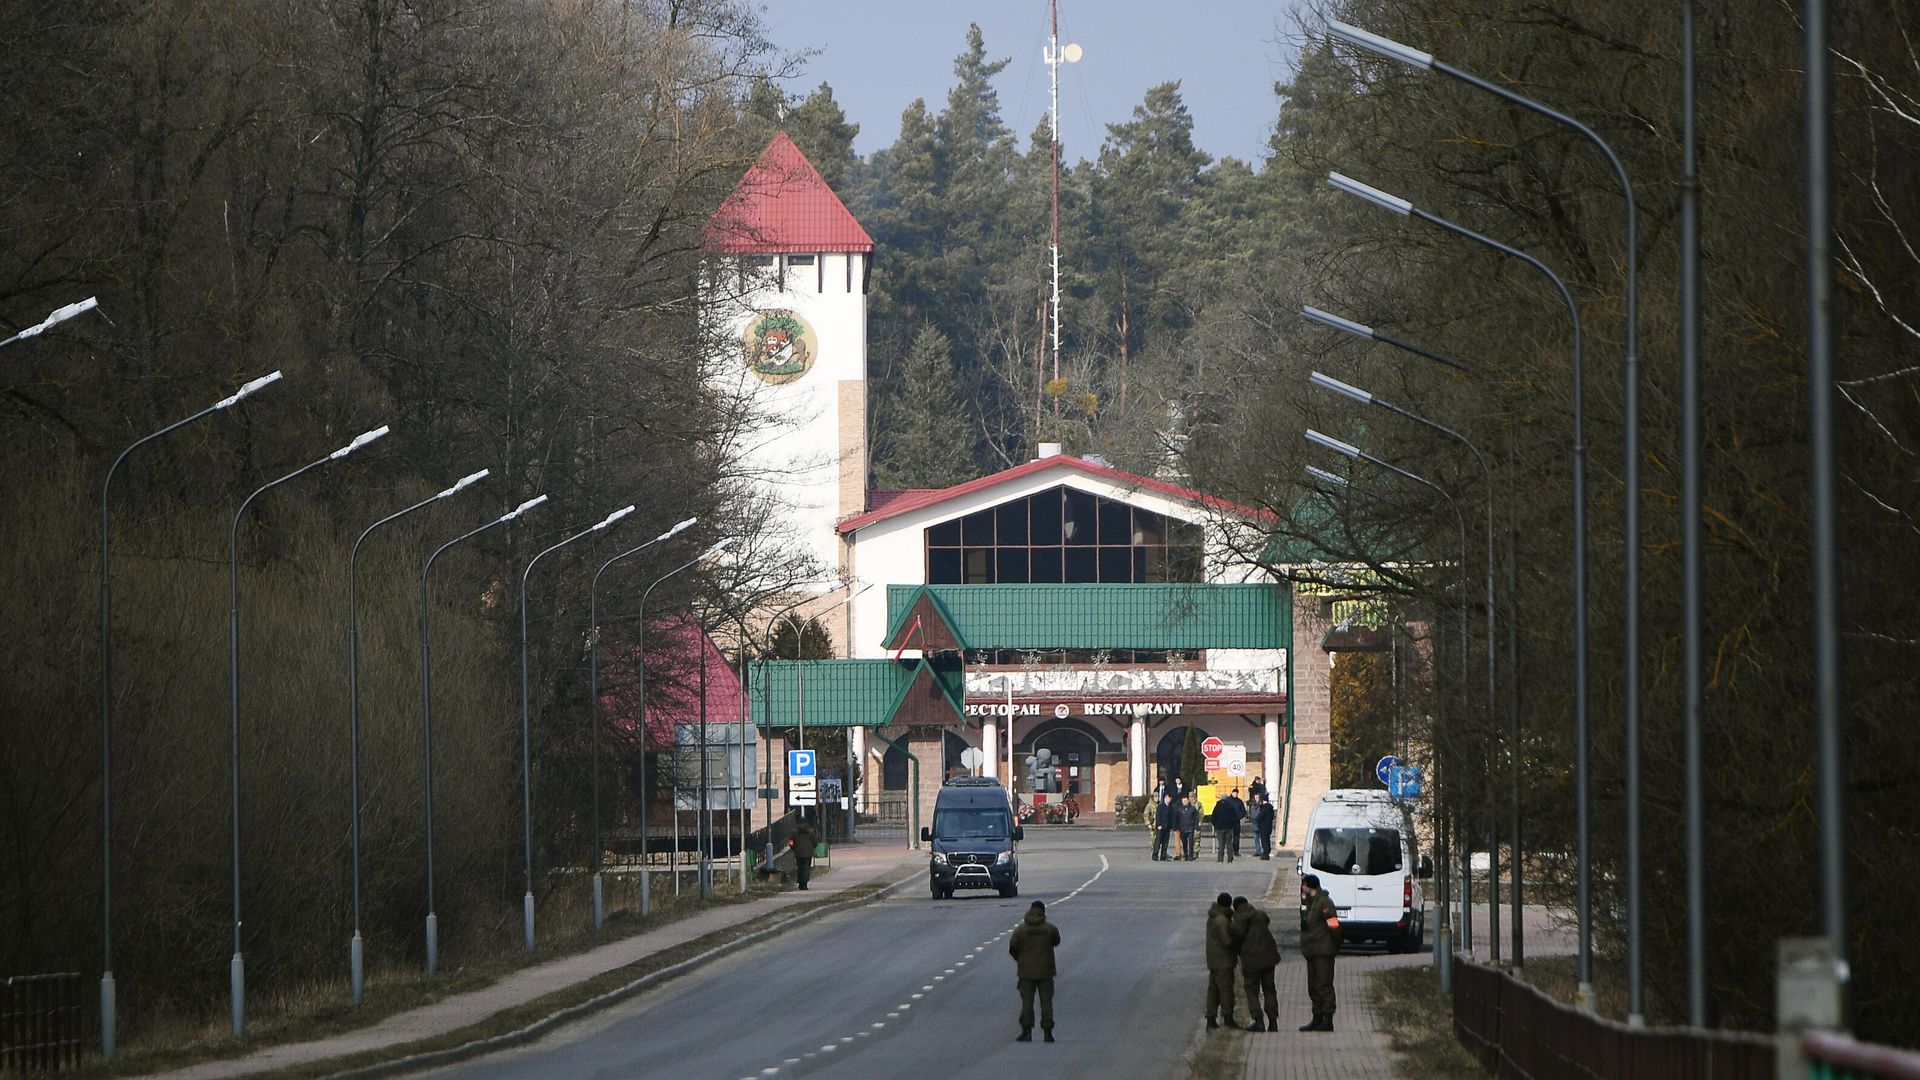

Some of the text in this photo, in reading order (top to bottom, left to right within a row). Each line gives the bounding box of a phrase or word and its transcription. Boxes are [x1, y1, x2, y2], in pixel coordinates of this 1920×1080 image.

[1204, 744, 1222, 752] STOP
[796, 753, 810, 774] P
[1232, 763, 1242, 771] 40
